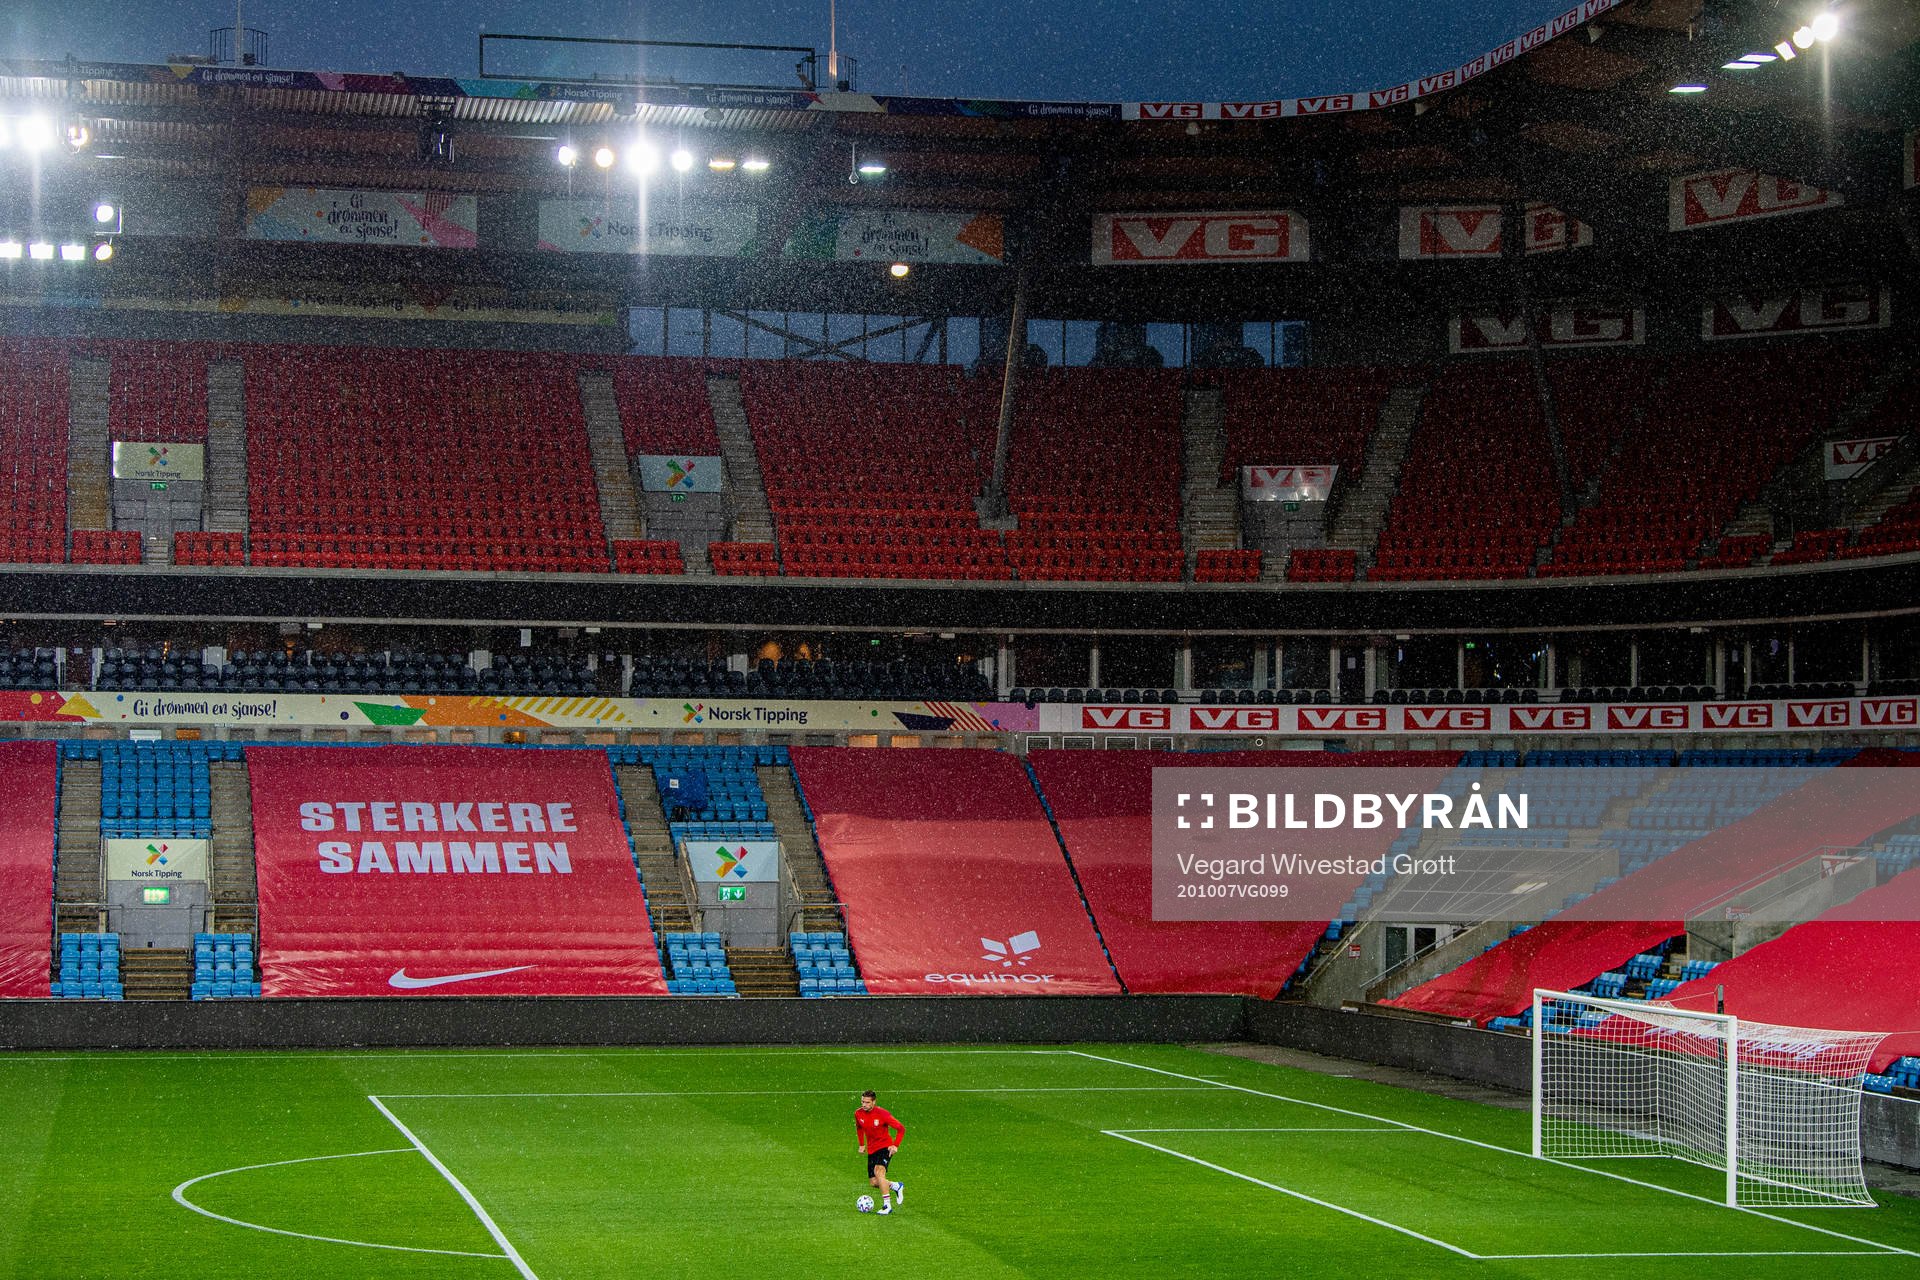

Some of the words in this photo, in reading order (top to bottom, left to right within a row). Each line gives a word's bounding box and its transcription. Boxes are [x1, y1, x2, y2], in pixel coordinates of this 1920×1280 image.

[1142, 103, 1199, 118] VG
[1223, 102, 1278, 118] VG
[1299, 95, 1349, 113] VG
[1371, 86, 1408, 106] VG
[1421, 72, 1454, 94] VG
[1462, 58, 1484, 82] VG
[1490, 41, 1514, 67] VG
[1521, 26, 1545, 49] VG
[1552, 9, 1577, 34] VG
[355, 219, 398, 242] sjanse!
[1118, 217, 1281, 258] VG
[133, 698, 149, 717] Gi
[153, 698, 209, 717] drømmen
[212, 702, 228, 716] en
[231, 699, 277, 720] sjanse!
[709, 706, 752, 721] Norsk
[753, 707, 808, 725] Tipping
[1086, 709, 1167, 728] VG
[1193, 709, 1275, 728] VG
[1300, 709, 1383, 729] VG
[1409, 709, 1486, 729] VG
[1511, 708, 1585, 728] VG
[1611, 707, 1684, 727] VG
[1704, 705, 1769, 726] VG
[1790, 703, 1847, 725] VG
[1863, 701, 1918, 723] VG
[300, 801, 578, 833] STERKERE
[318, 841, 573, 874] SAMMEN
[131, 869, 154, 877] Norsk
[154, 869, 183, 879] Tipping
[925, 970, 1055, 986] equinor
